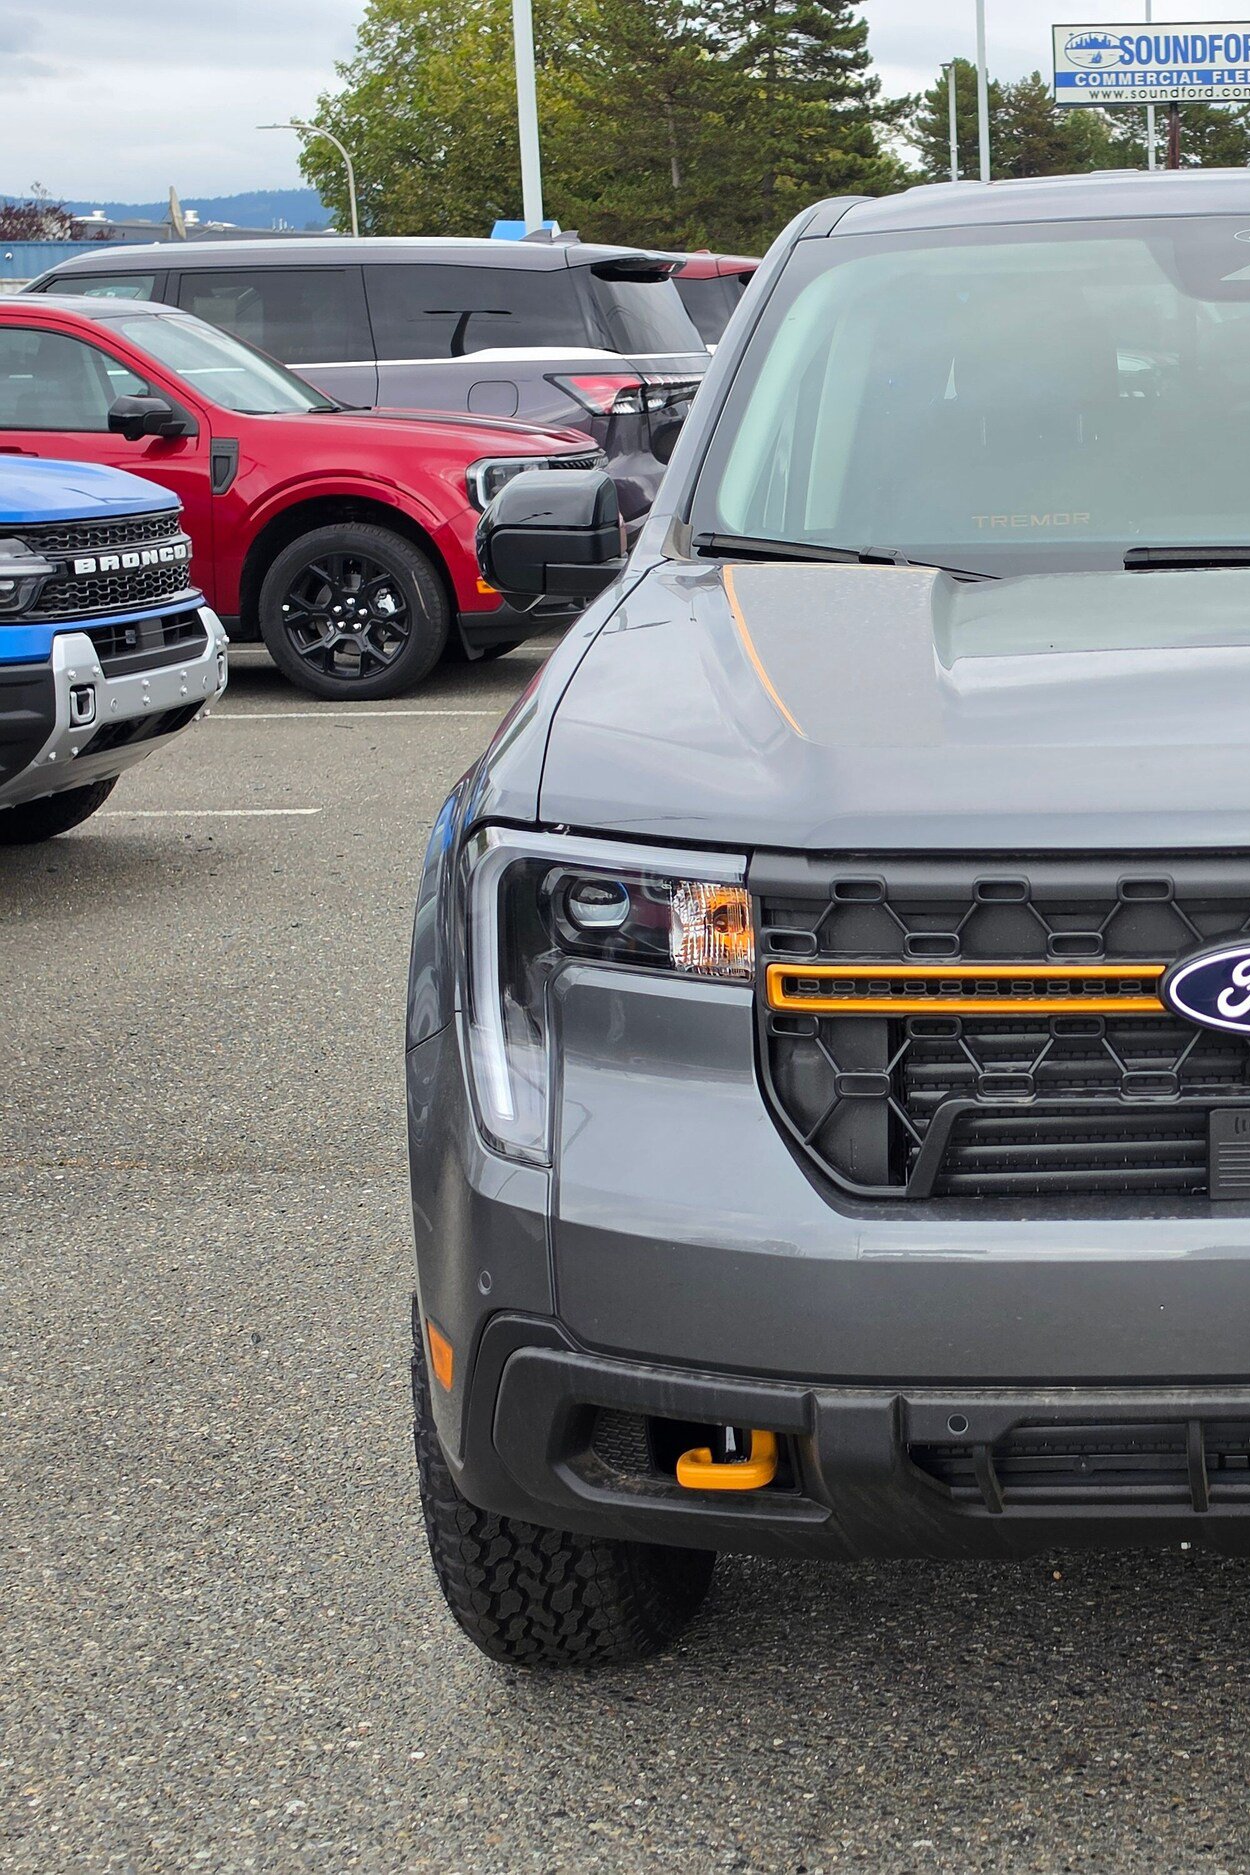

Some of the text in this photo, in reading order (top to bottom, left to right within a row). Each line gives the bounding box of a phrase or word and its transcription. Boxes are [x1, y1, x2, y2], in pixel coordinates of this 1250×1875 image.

[1074, 72, 1202, 87] COMMERCIAL
[970, 512, 1091, 528] TREMOR
[74, 544, 186, 575] BRONCO
